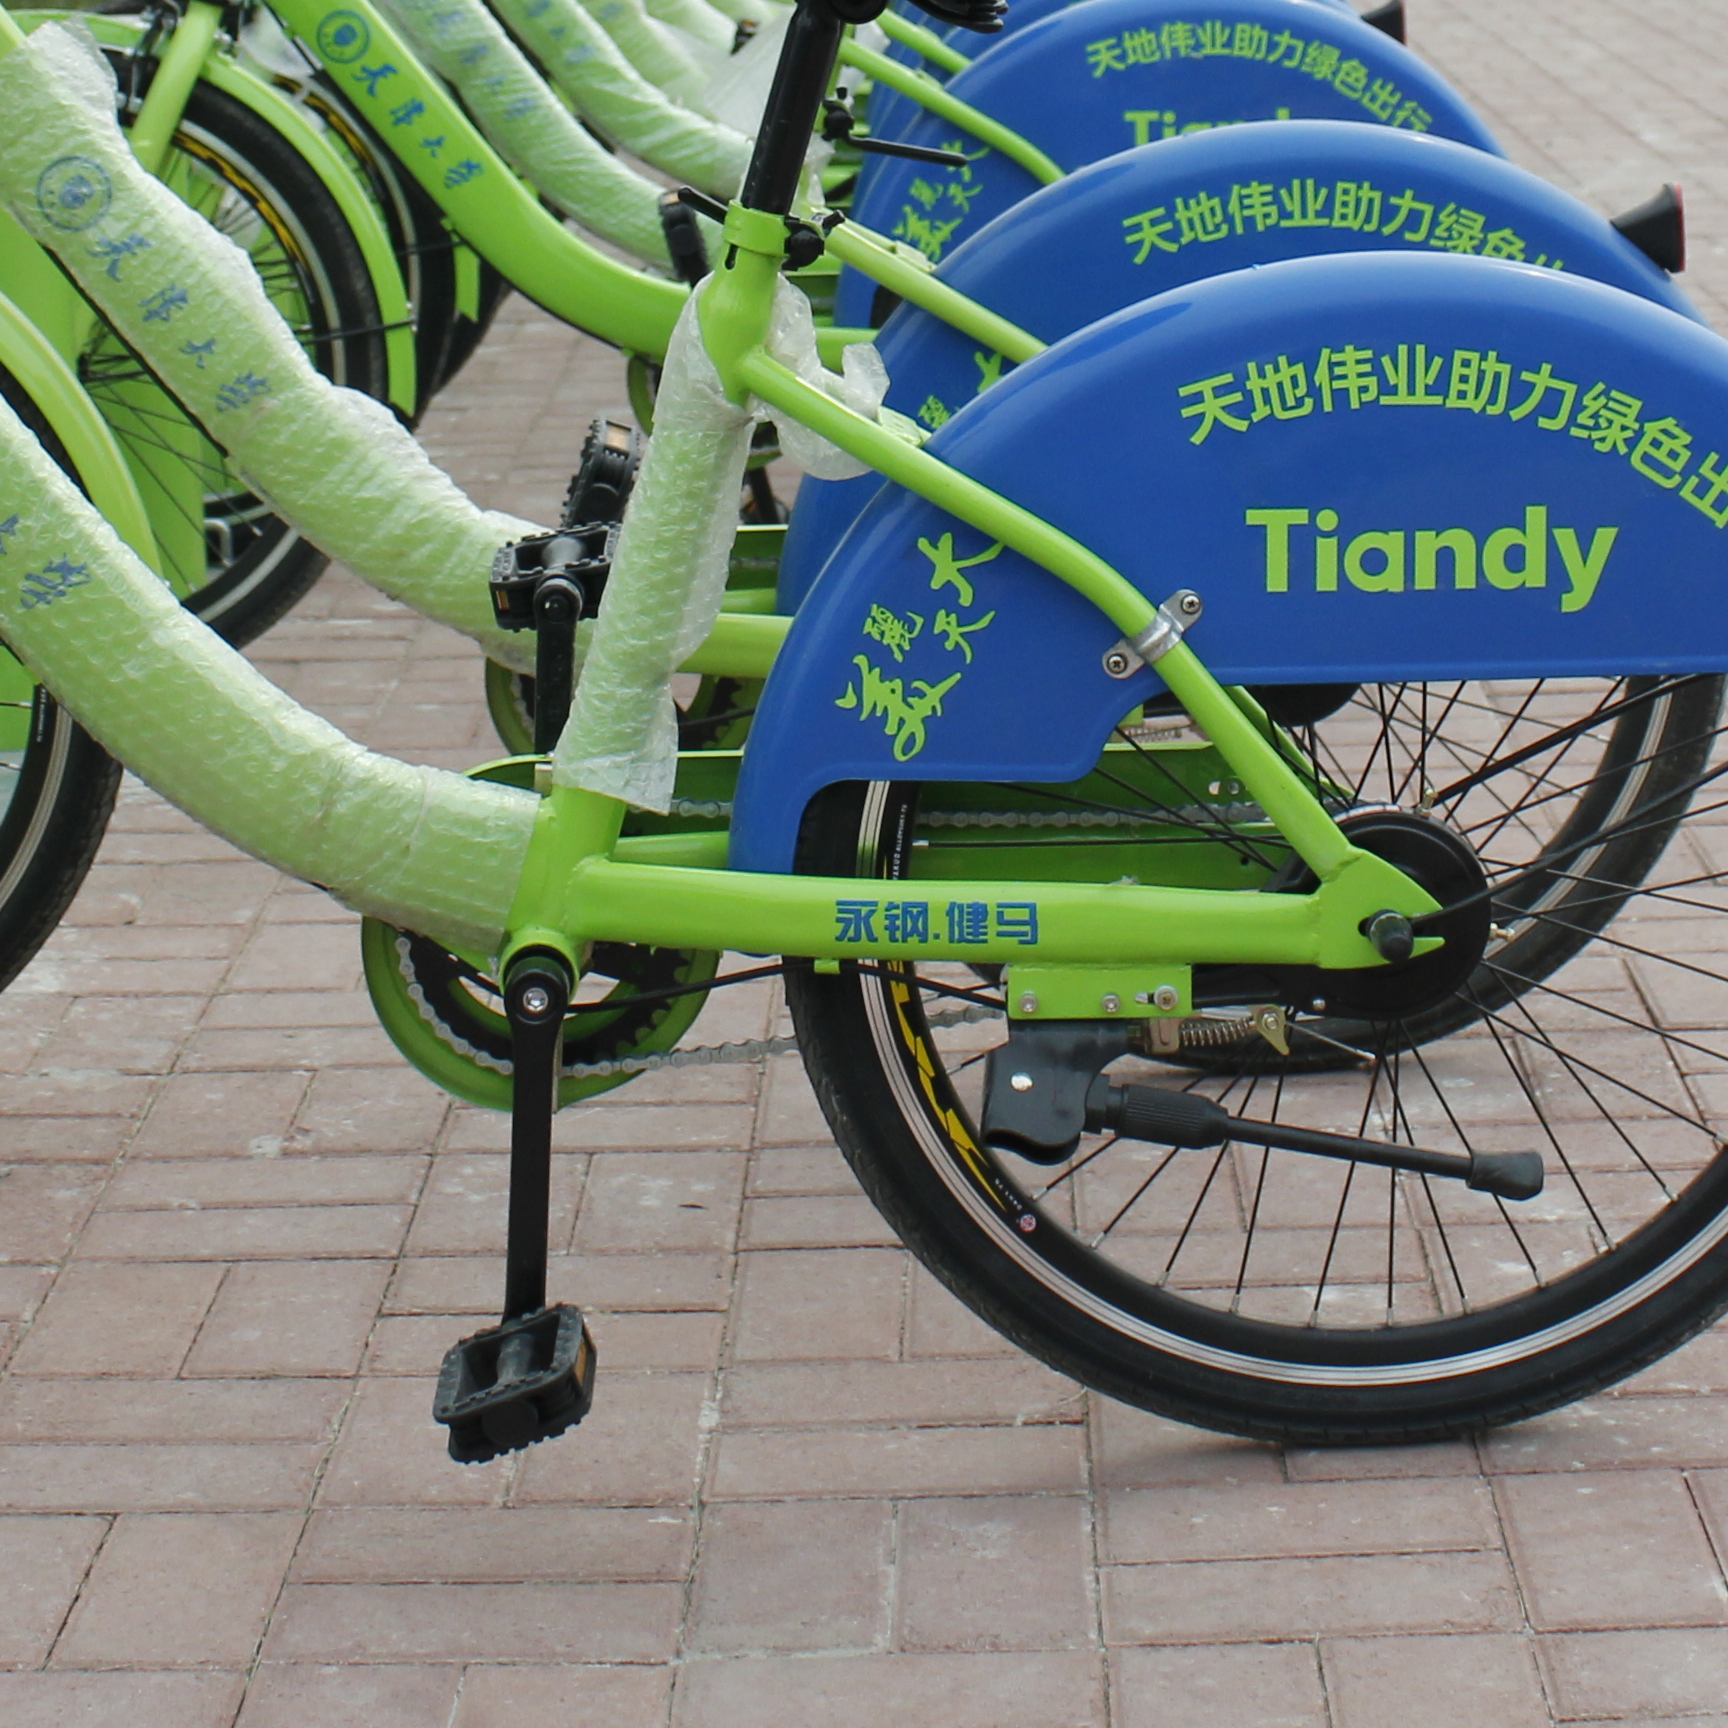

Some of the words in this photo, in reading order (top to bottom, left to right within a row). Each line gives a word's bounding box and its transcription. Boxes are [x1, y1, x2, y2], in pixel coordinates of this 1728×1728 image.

[1084, 19, 1434, 132] 天地伟业助力绿色出行
[1121, 177, 1565, 271] 天地伟业助力绿色
[1245, 504, 1620, 614] Tiandy
[834, 899, 1039, 946] 永钢.健马
